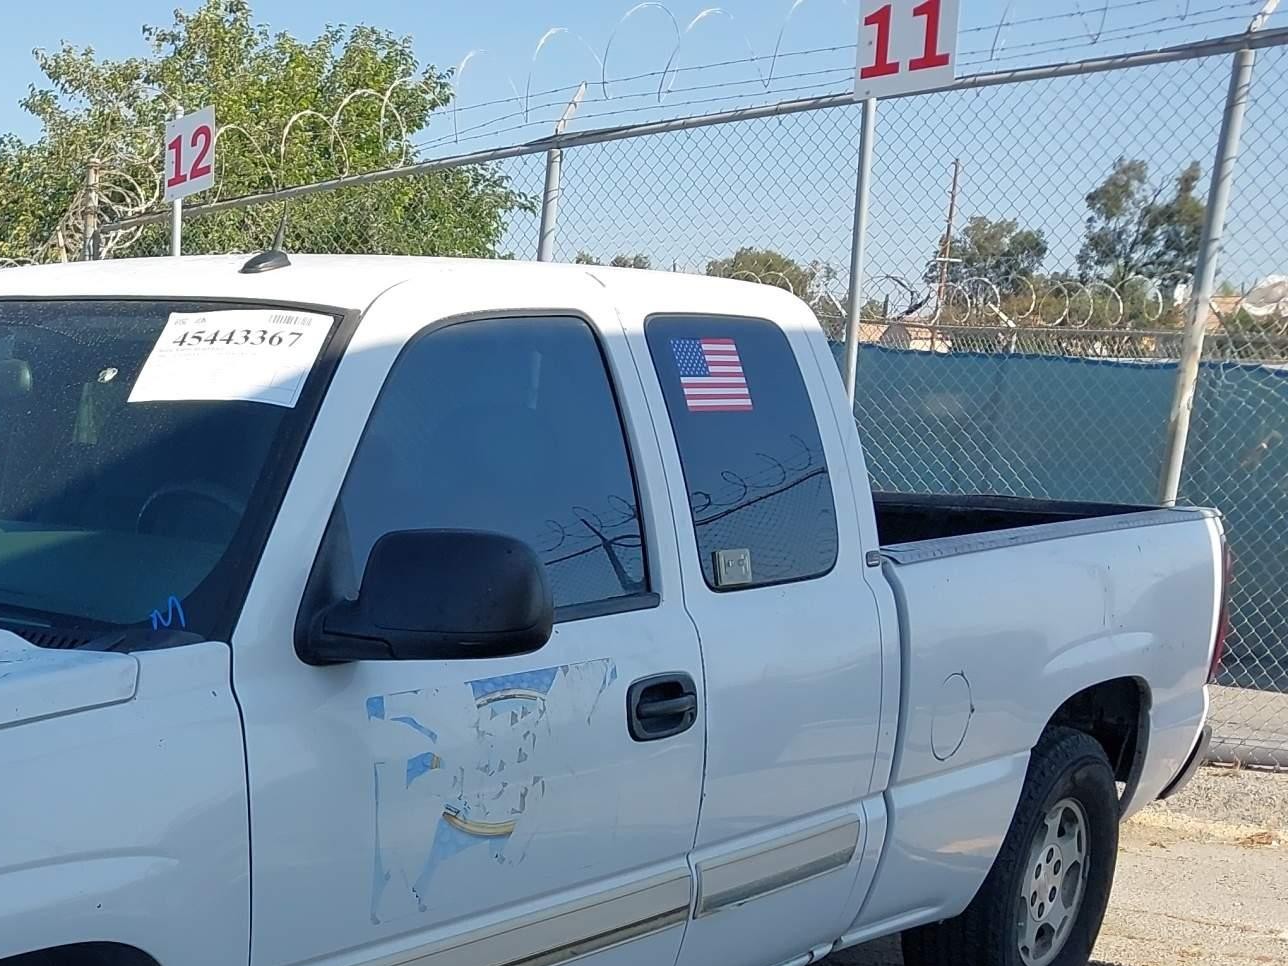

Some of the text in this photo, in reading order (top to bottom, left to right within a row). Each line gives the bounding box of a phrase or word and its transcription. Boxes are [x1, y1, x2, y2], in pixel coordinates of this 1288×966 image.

[860, 0, 950, 80] 11
[167, 125, 212, 187] 12
[171, 329, 303, 348] 45443367
[149, 596, 186, 631] M
